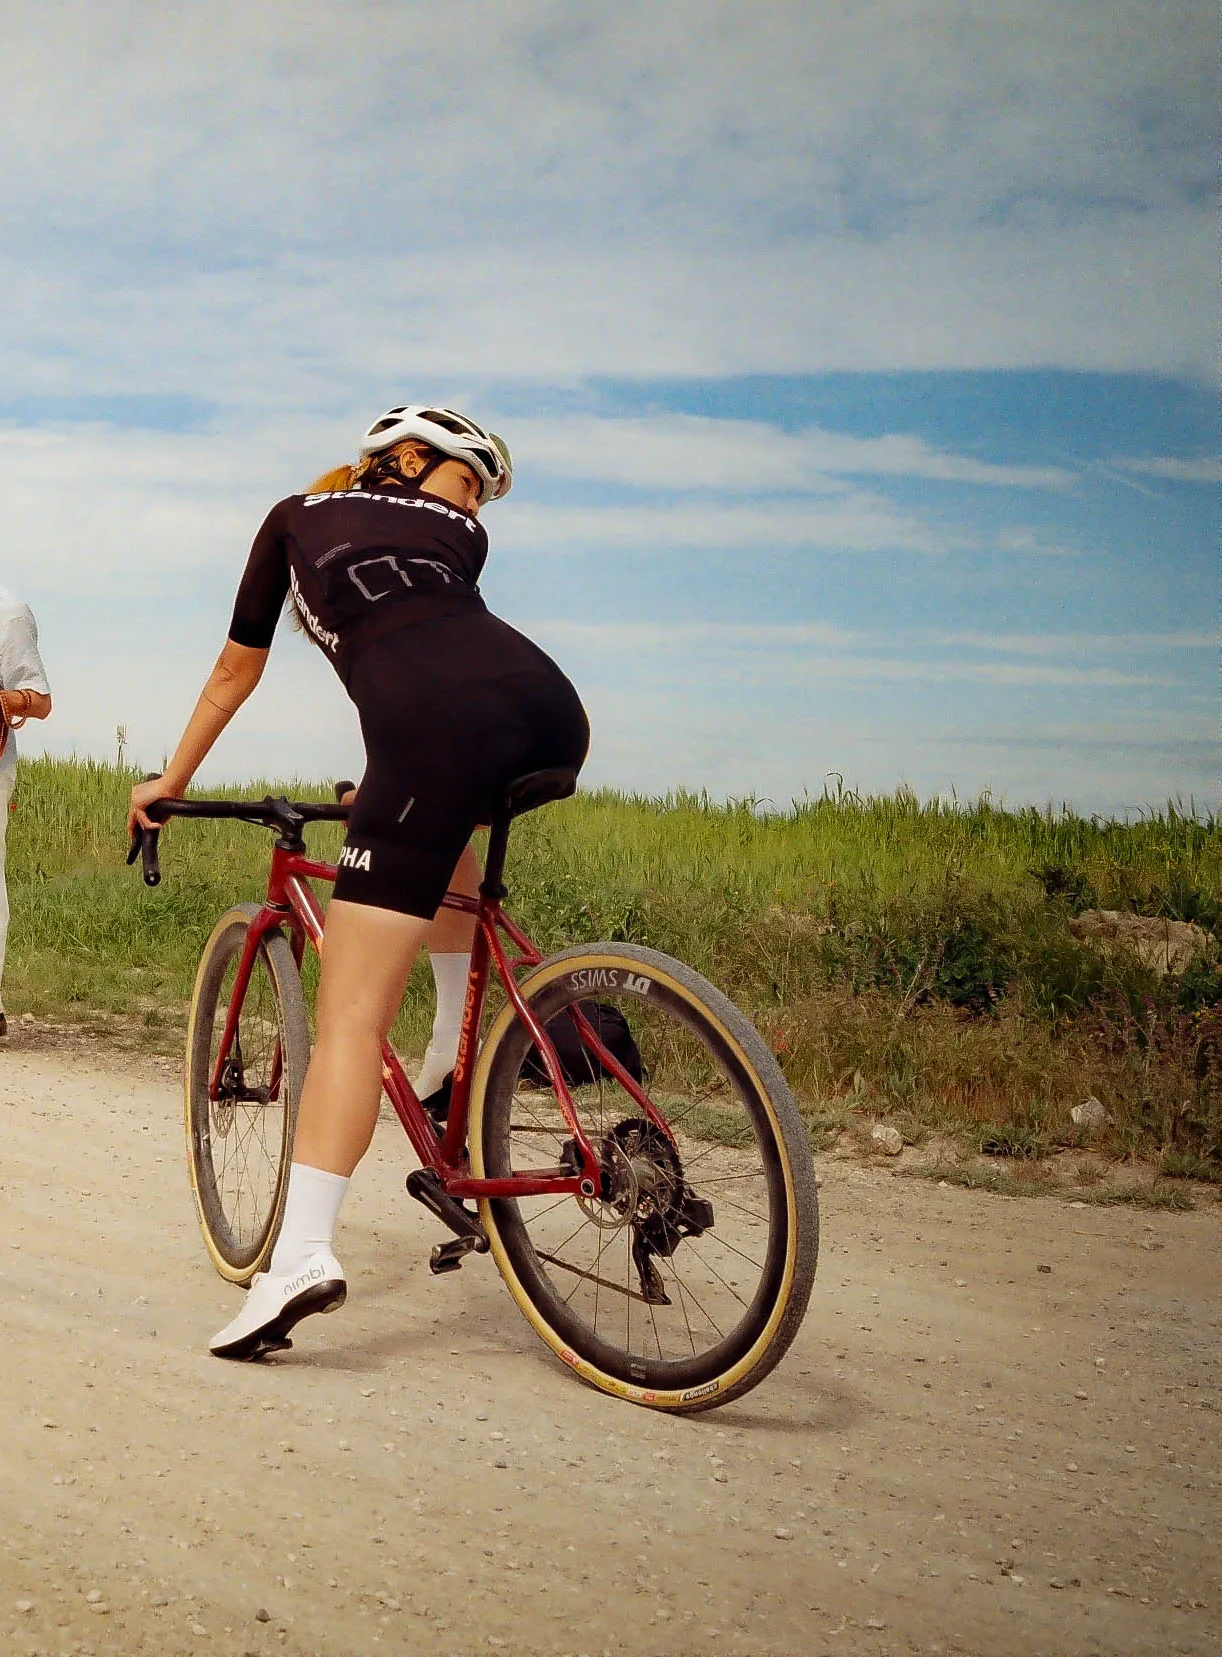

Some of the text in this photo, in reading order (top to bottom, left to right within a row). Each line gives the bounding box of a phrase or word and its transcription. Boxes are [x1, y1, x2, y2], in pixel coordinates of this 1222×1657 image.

[303, 491, 477, 533] Standert
[571, 970, 651, 995] DT SWISS
[283, 1264, 325, 1296] nimbl
